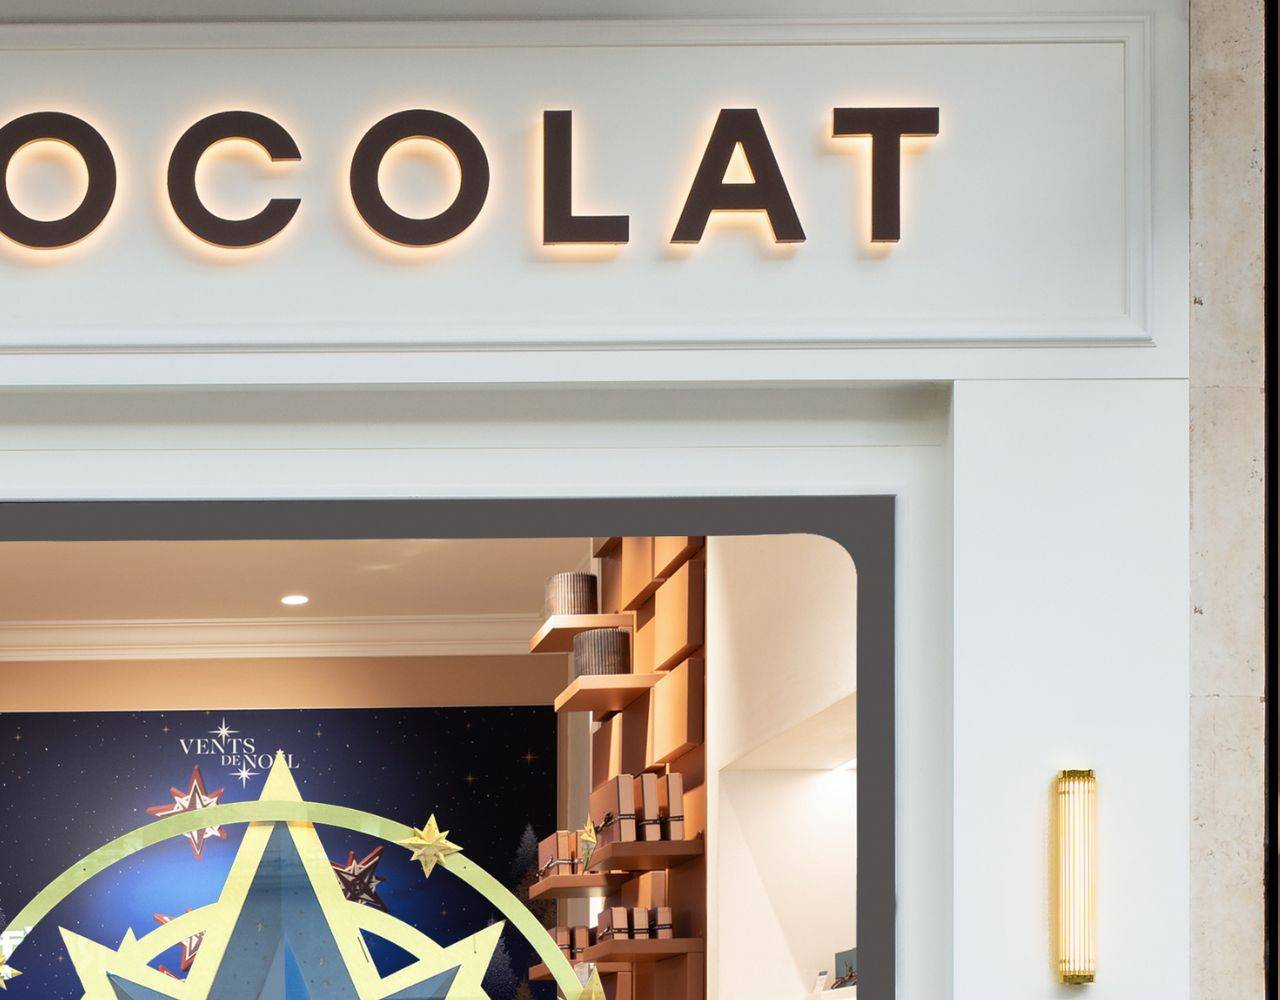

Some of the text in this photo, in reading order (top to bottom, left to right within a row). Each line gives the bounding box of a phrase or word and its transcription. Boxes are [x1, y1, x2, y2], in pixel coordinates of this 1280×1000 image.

[180, 738, 256, 755] VENTS
[221, 753, 300, 770] DE NOL
